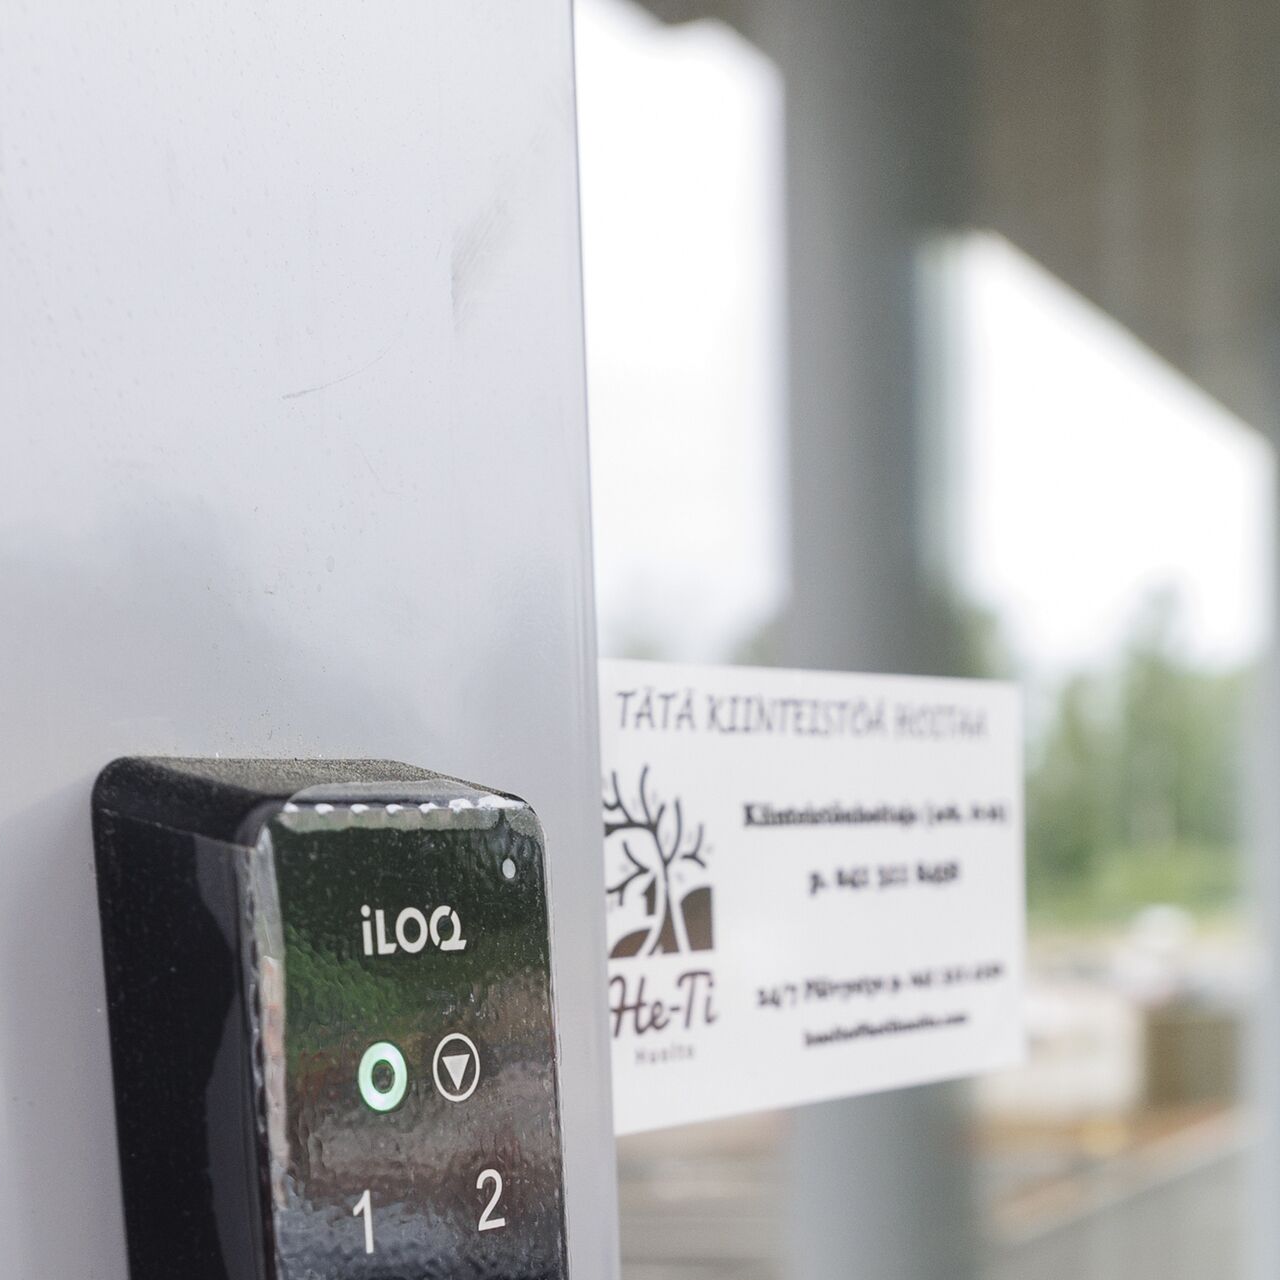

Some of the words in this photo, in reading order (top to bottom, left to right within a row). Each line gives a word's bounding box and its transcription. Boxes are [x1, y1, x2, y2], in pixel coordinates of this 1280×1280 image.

[617, 686, 698, 733] TÄTÄ
[361, 904, 467, 956] iLOQ
[352, 1189, 375, 1254] 1
[476, 1168, 506, 1232] 2
